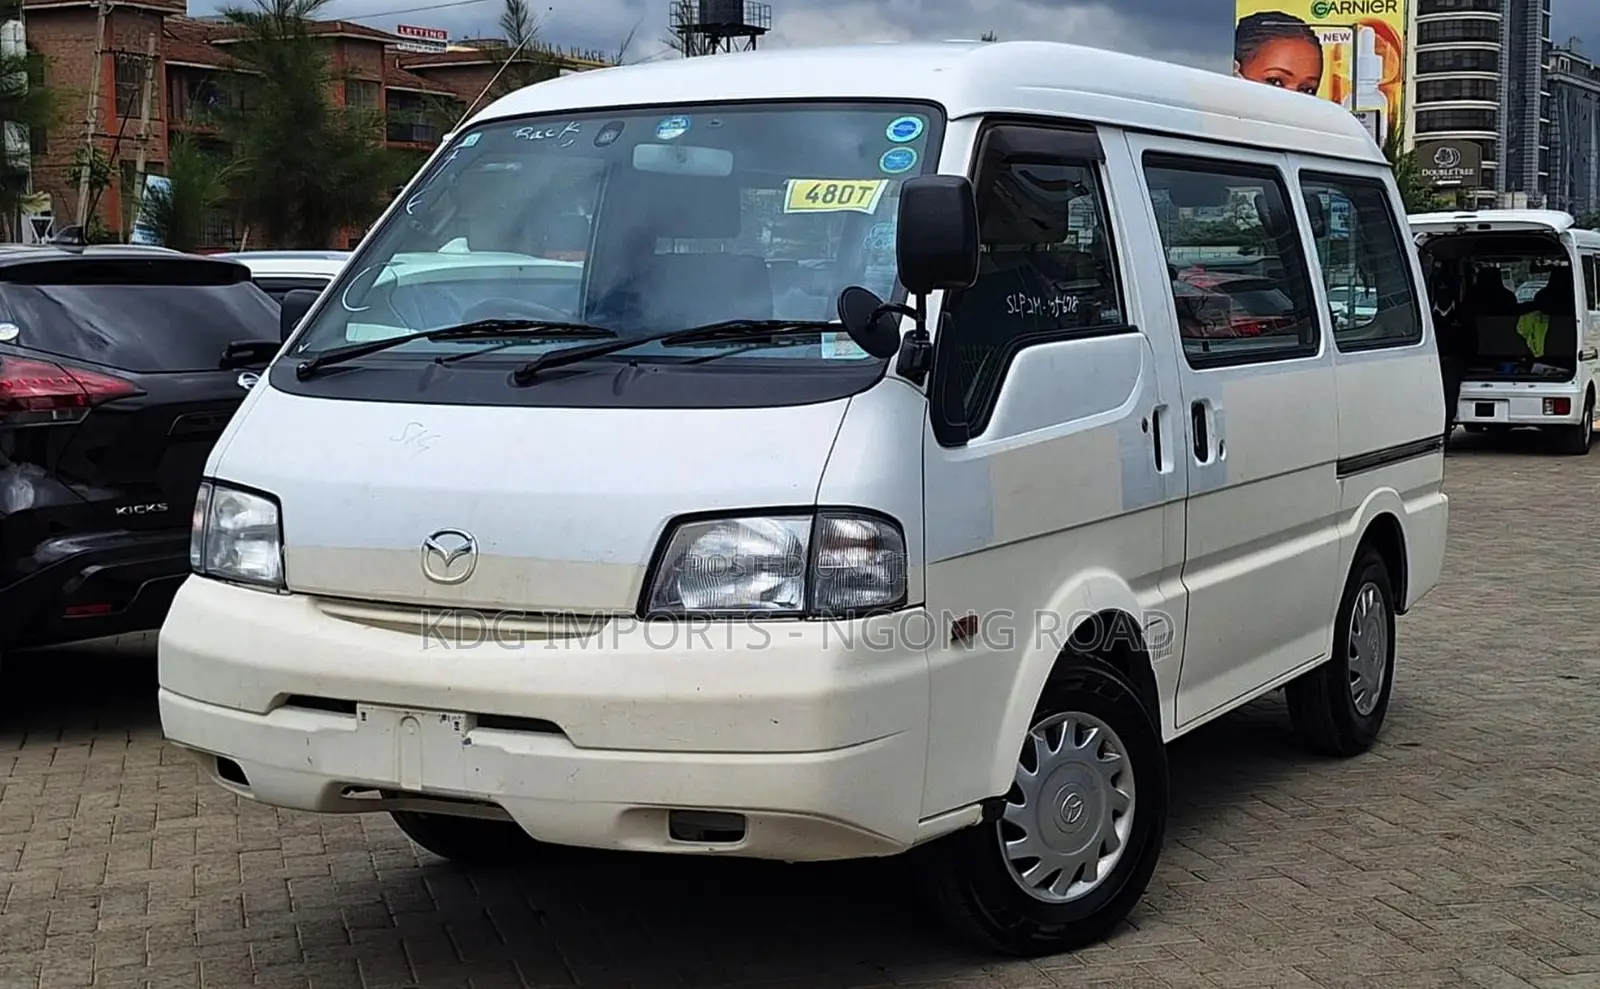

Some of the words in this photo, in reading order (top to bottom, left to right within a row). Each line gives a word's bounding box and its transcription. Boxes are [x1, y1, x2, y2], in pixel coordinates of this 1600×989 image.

[400, 26, 444, 39] LETTING
[1323, 33, 1351, 42] NEW
[805, 183, 874, 205] 480T
[115, 502, 169, 515] KICKS
